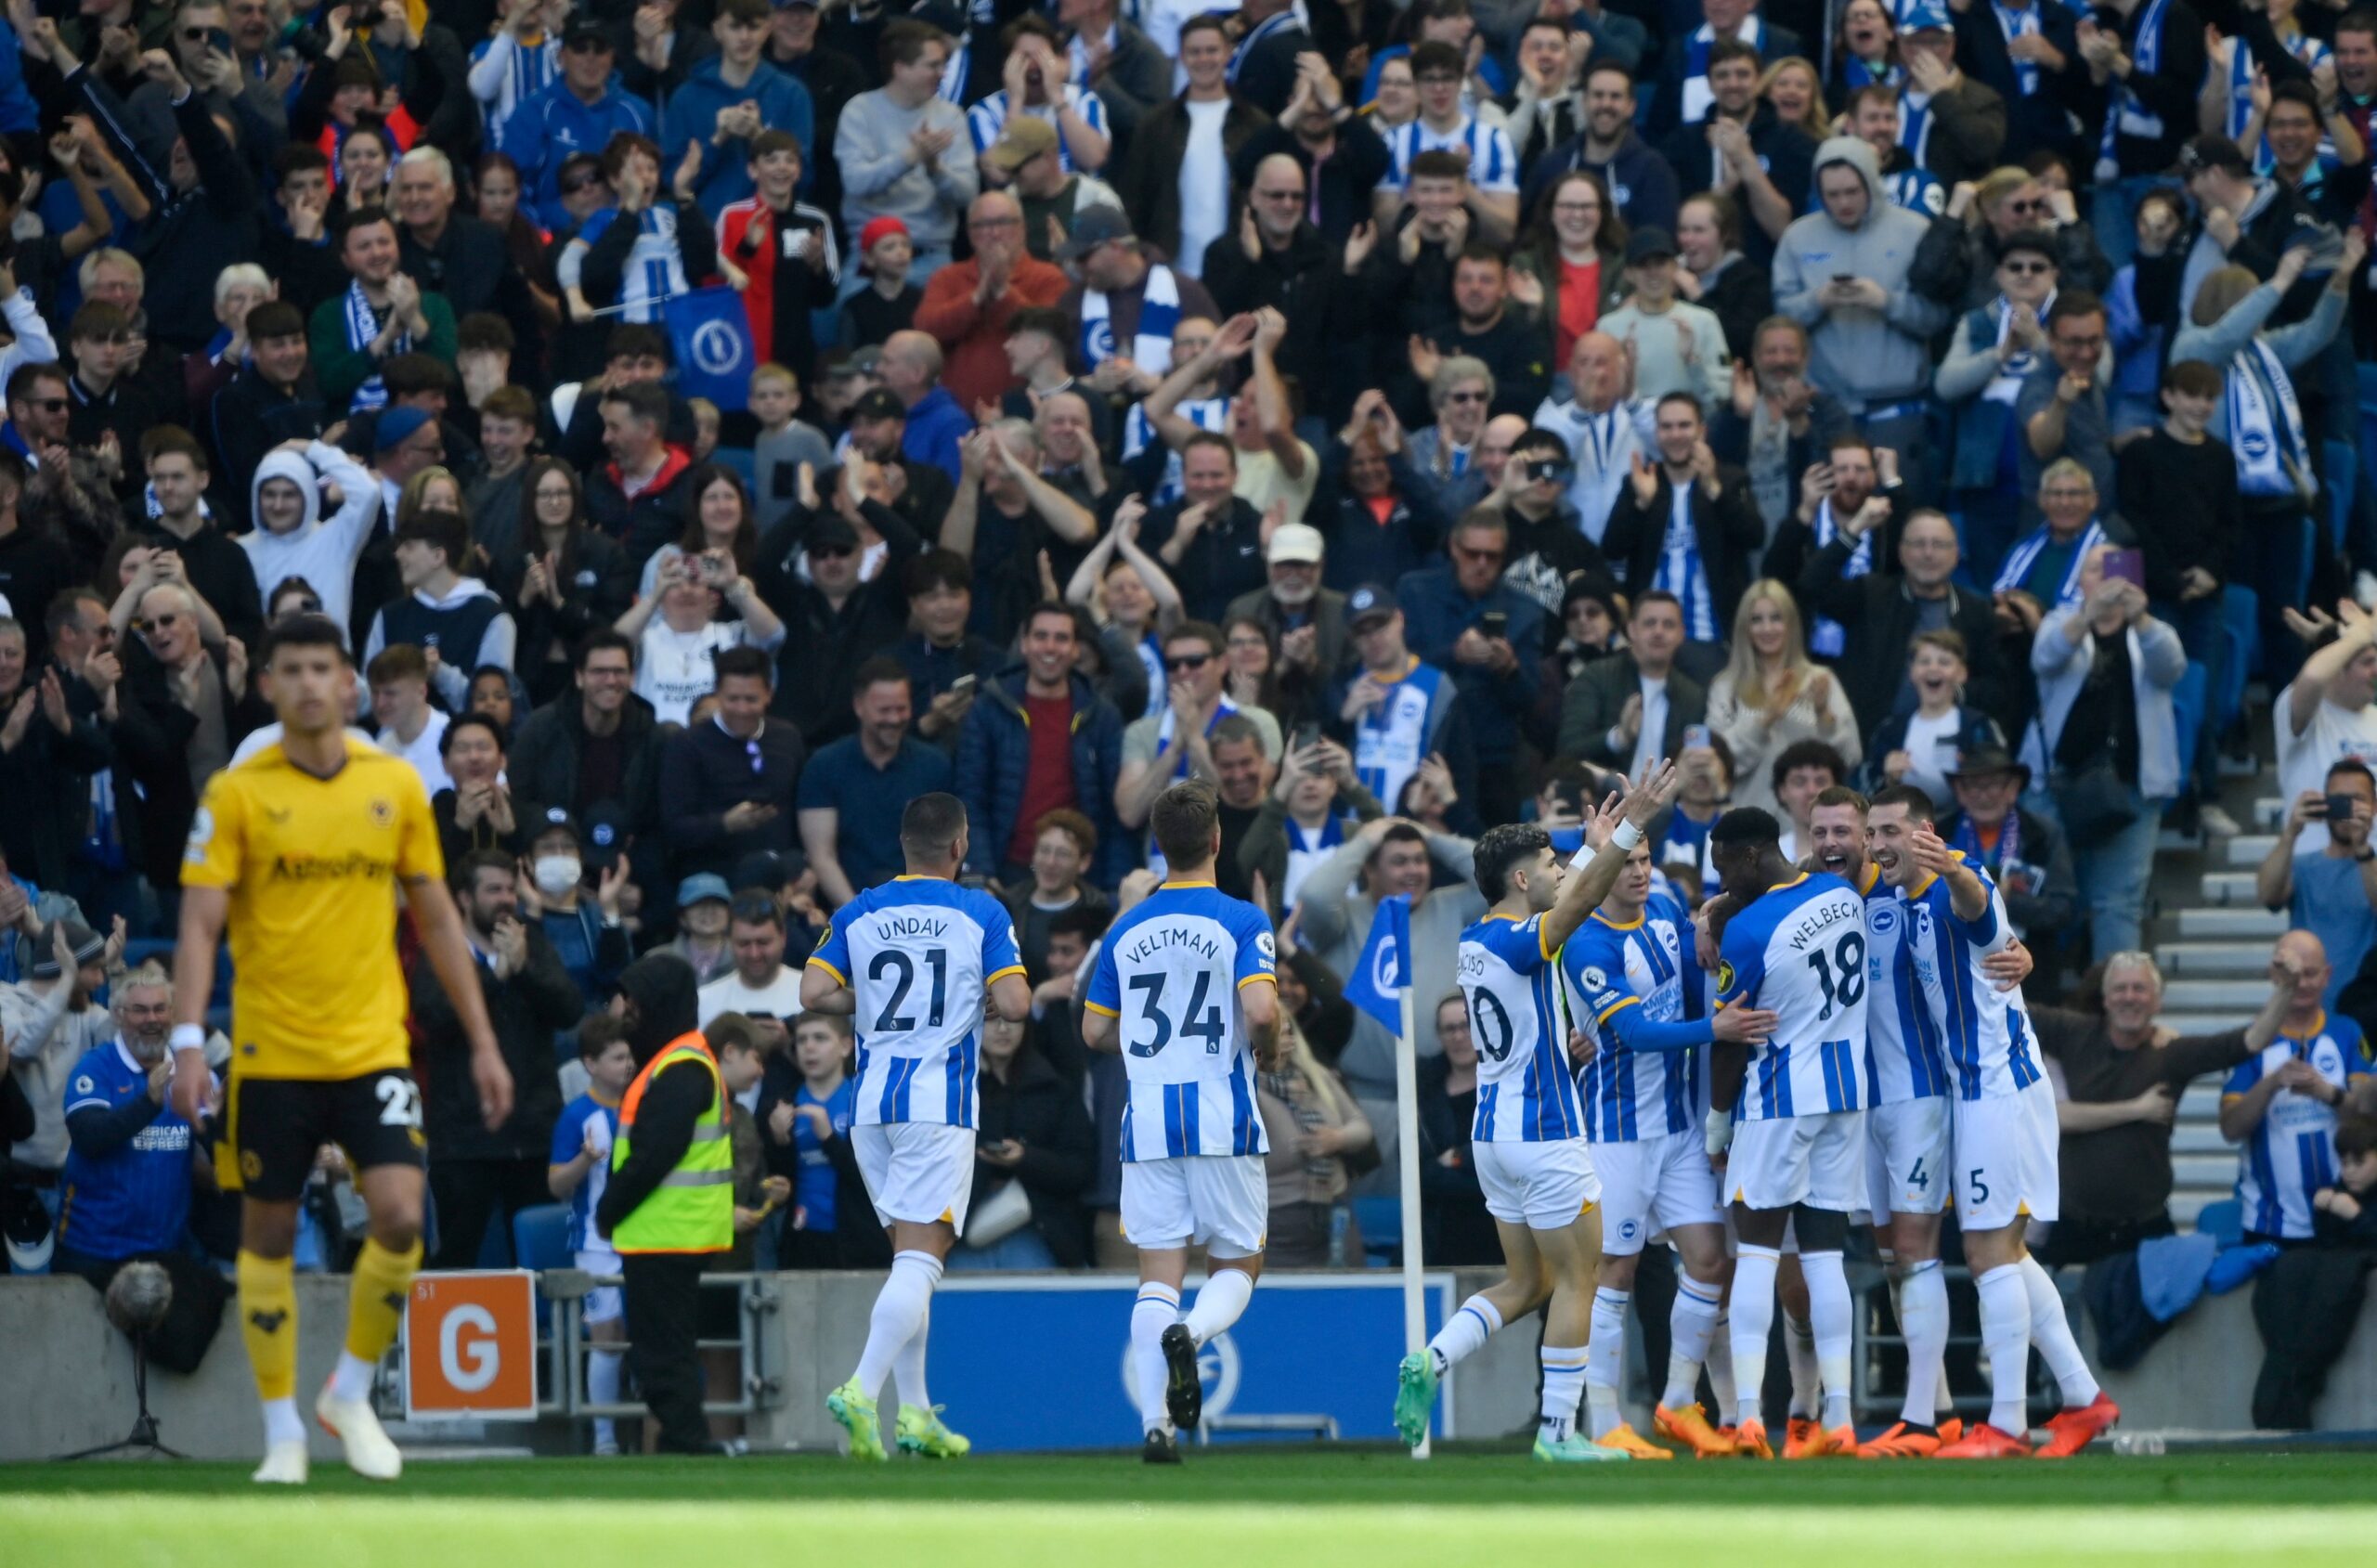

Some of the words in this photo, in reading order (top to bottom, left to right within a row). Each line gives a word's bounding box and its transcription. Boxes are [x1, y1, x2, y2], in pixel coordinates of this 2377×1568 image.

[877, 917, 948, 940] UNDAV
[1125, 927, 1219, 965] VELTMAN
[1789, 901, 1860, 952] WELBECK
[868, 948, 947, 1032] 21
[1808, 930, 1865, 1021] 18
[1128, 970, 1226, 1058] 34
[1907, 1156, 1929, 1192] 4
[1969, 1168, 1989, 1205] 5
[439, 1302, 500, 1393] G
